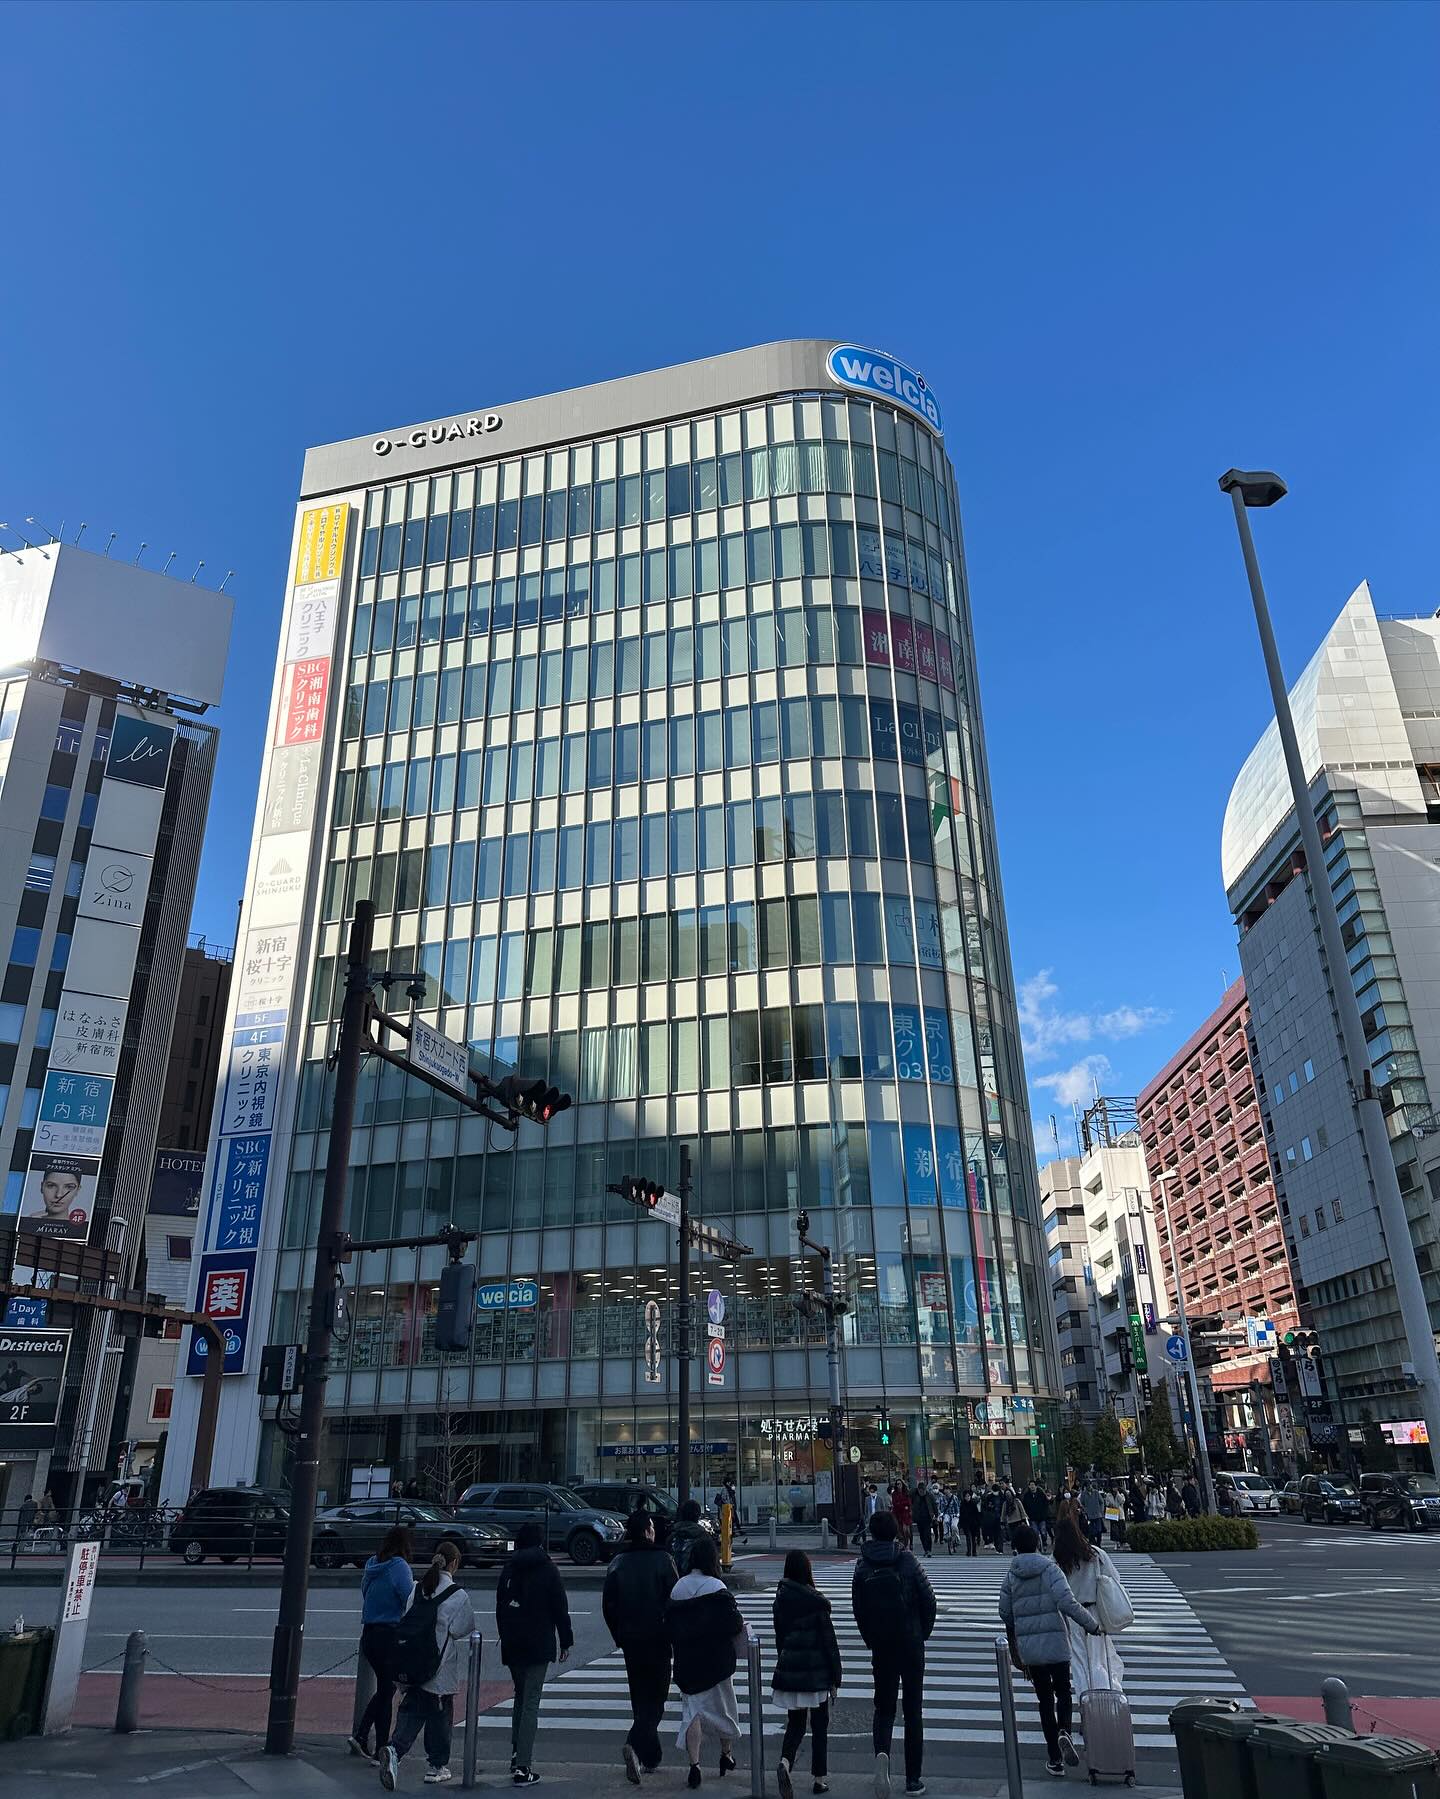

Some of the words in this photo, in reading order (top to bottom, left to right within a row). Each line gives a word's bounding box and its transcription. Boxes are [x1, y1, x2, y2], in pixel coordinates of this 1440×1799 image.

[840, 357, 939, 427] welcia
[372, 413, 502, 455] O-GUARD
[313, 600, 327, 633] 八王子
[297, 603, 313, 657] クリニック
[297, 661, 325, 676] SBC
[291, 680, 309, 740] クリニック
[304, 675, 323, 738] 湘南歯科
[93, 892, 132, 911] Zina
[256, 935, 287, 954] 新宿
[246, 955, 292, 975] 桜十字
[250, 976, 284, 986] クリニック
[63, 1010, 121, 1028] はなふさ
[254, 1013, 269, 1023] 5F
[76, 1025, 120, 1042] 皮膚科
[250, 1031, 268, 1043] 4F
[77, 1042, 116, 1058] 新宿院
[415, 1025, 467, 1074] 新宿大ガード西
[57, 1077, 102, 1097] 新宿
[233, 1049, 255, 1129] クリニック
[248, 1047, 272, 1128] 東京内視鏡
[53, 1101, 97, 1121] 内科
[235, 1140, 266, 1155] SBC
[223, 1160, 247, 1246] クリニック
[239, 1159, 263, 1245] 新宿近視
[72, 1215, 84, 1223] 4F
[36, 1225, 69, 1235] MIARAY
[208, 1277, 241, 1313] 薬
[0, 1338, 64, 1352] Dr.stretch
[10, 1405, 30, 1420] 2F
[768, 1432, 817, 1442] PHARMAC
[71, 1547, 90, 1616] 駐停車禁止
